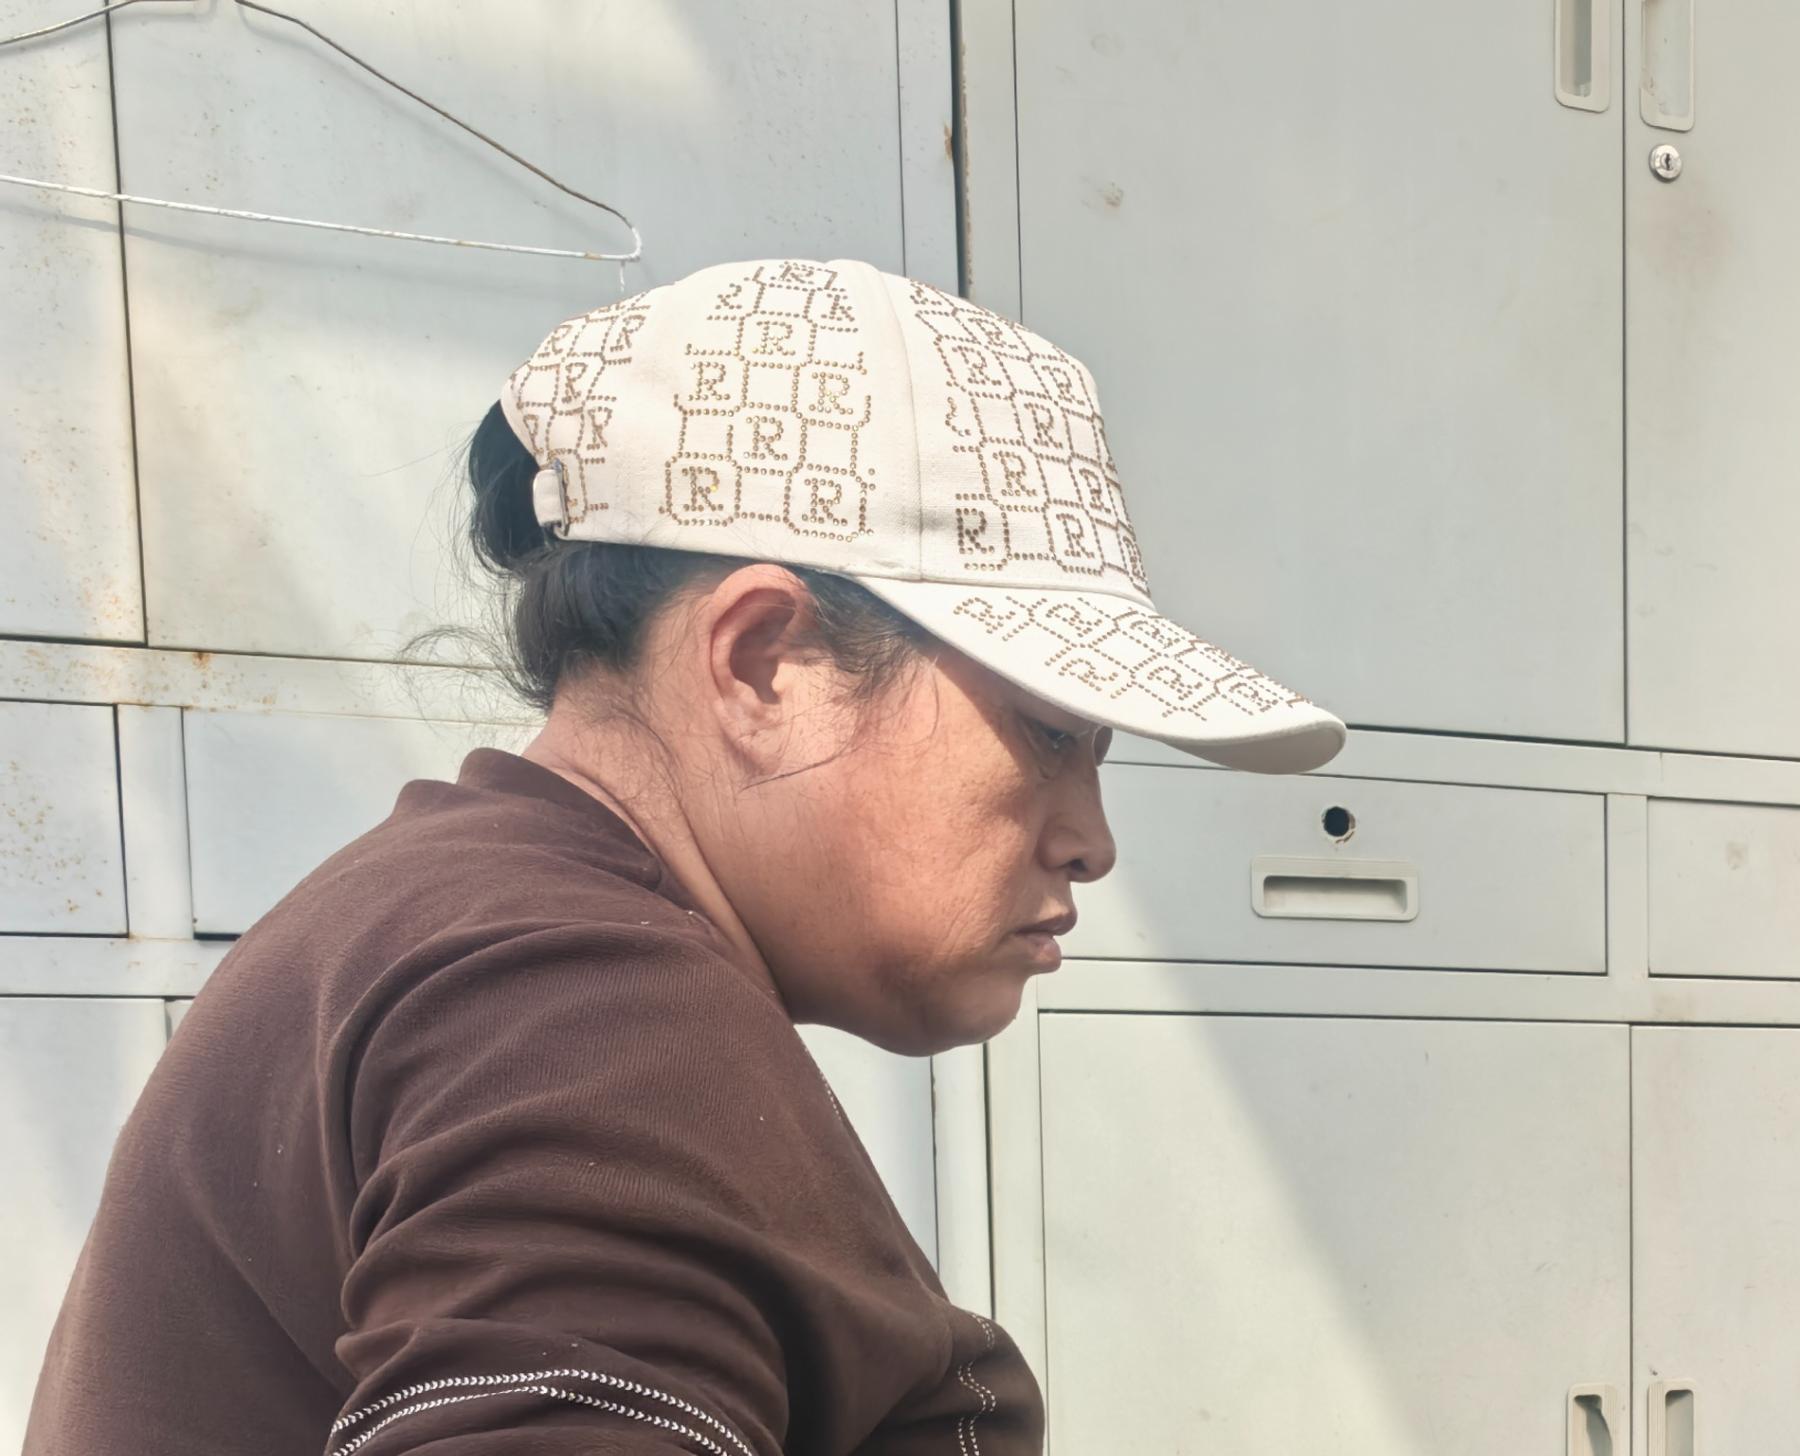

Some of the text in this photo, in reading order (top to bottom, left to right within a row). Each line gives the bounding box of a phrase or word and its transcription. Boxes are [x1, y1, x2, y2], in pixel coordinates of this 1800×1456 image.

[753, 320, 795, 356] R
[689, 361, 731, 401] R
[952, 345, 1001, 386] R
[809, 371, 854, 413] R
[743, 416, 788, 461] R
[1024, 402, 1063, 448] R
[682, 466, 724, 511] R
[993, 450, 1038, 497] R
[802, 478, 848, 526] R
[955, 508, 995, 554] R
[1056, 513, 1095, 558] R
